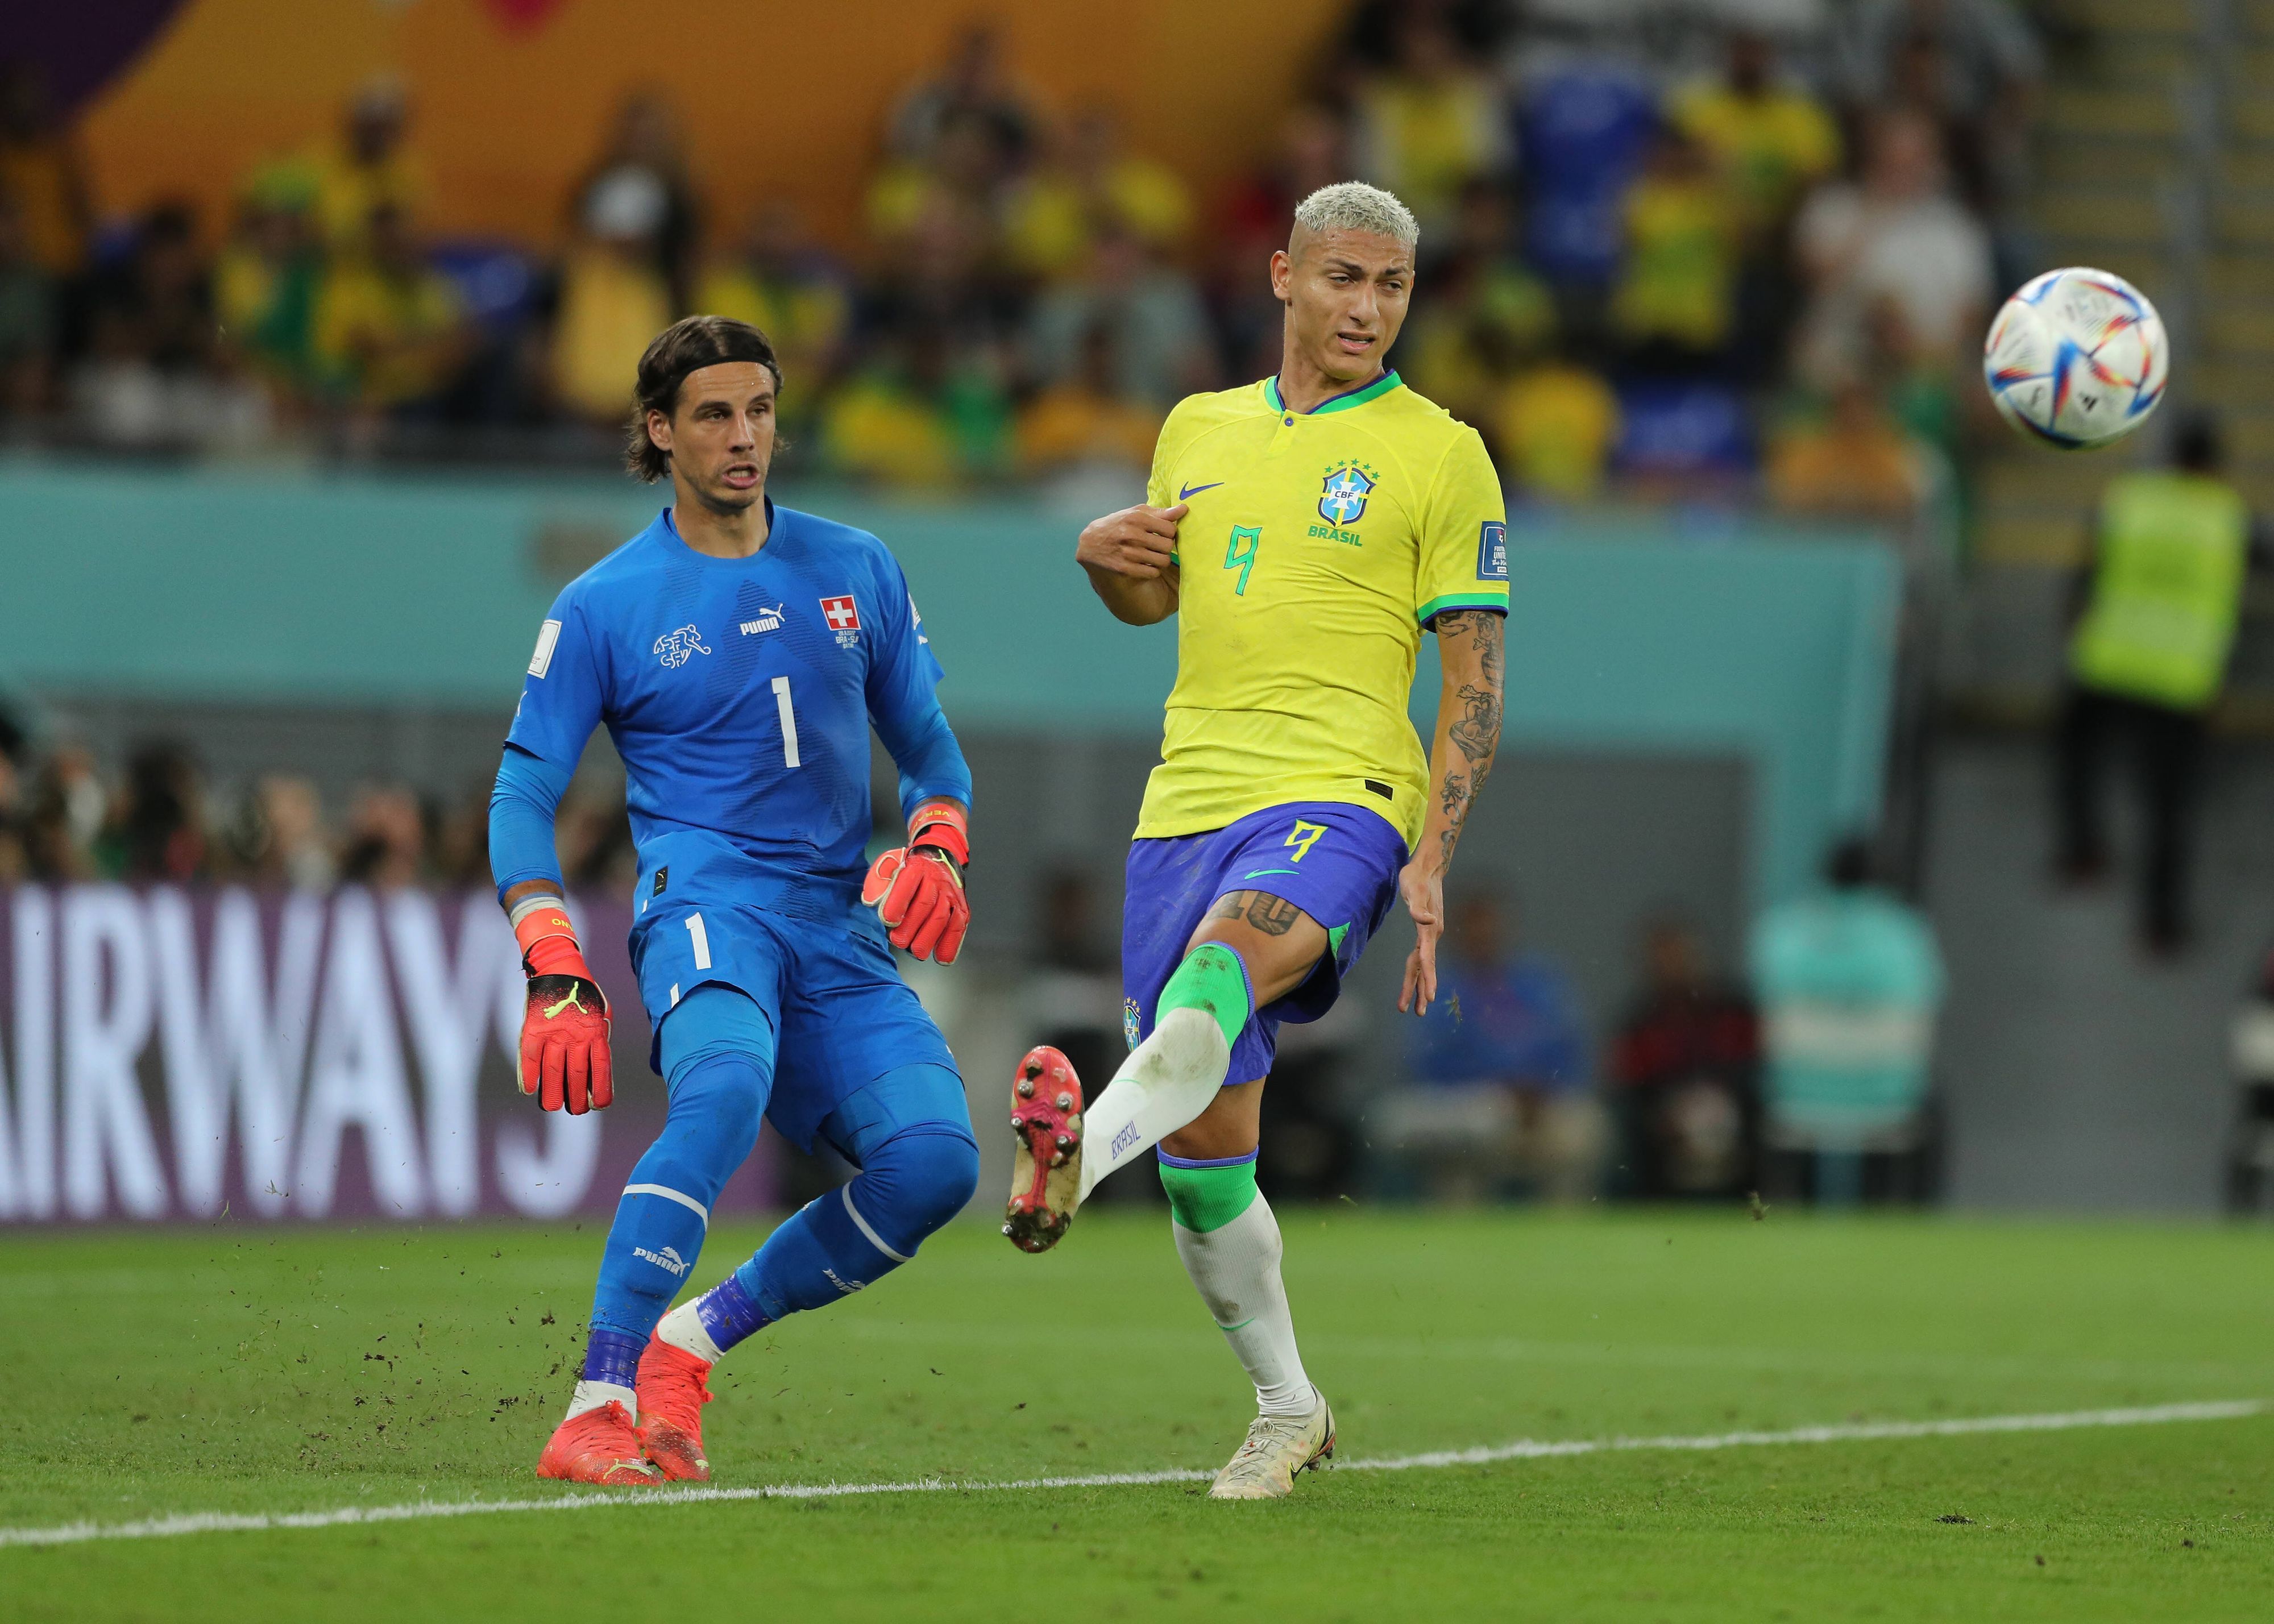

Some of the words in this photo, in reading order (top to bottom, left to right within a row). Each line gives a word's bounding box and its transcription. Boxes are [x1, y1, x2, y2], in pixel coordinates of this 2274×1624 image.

[1335, 491, 1354, 499] CBF
[1308, 525, 1363, 547] BRASIL
[1223, 524, 1263, 596] 9
[740, 617, 780, 636] PUMA
[771, 676, 800, 768] 1
[1283, 818, 1329, 863] 9
[684, 911, 712, 970] 1
[0, 880, 604, 1223] IRWAYS
[1112, 1120, 1141, 1160] BRASIL
[632, 1247, 680, 1275] PUMA
